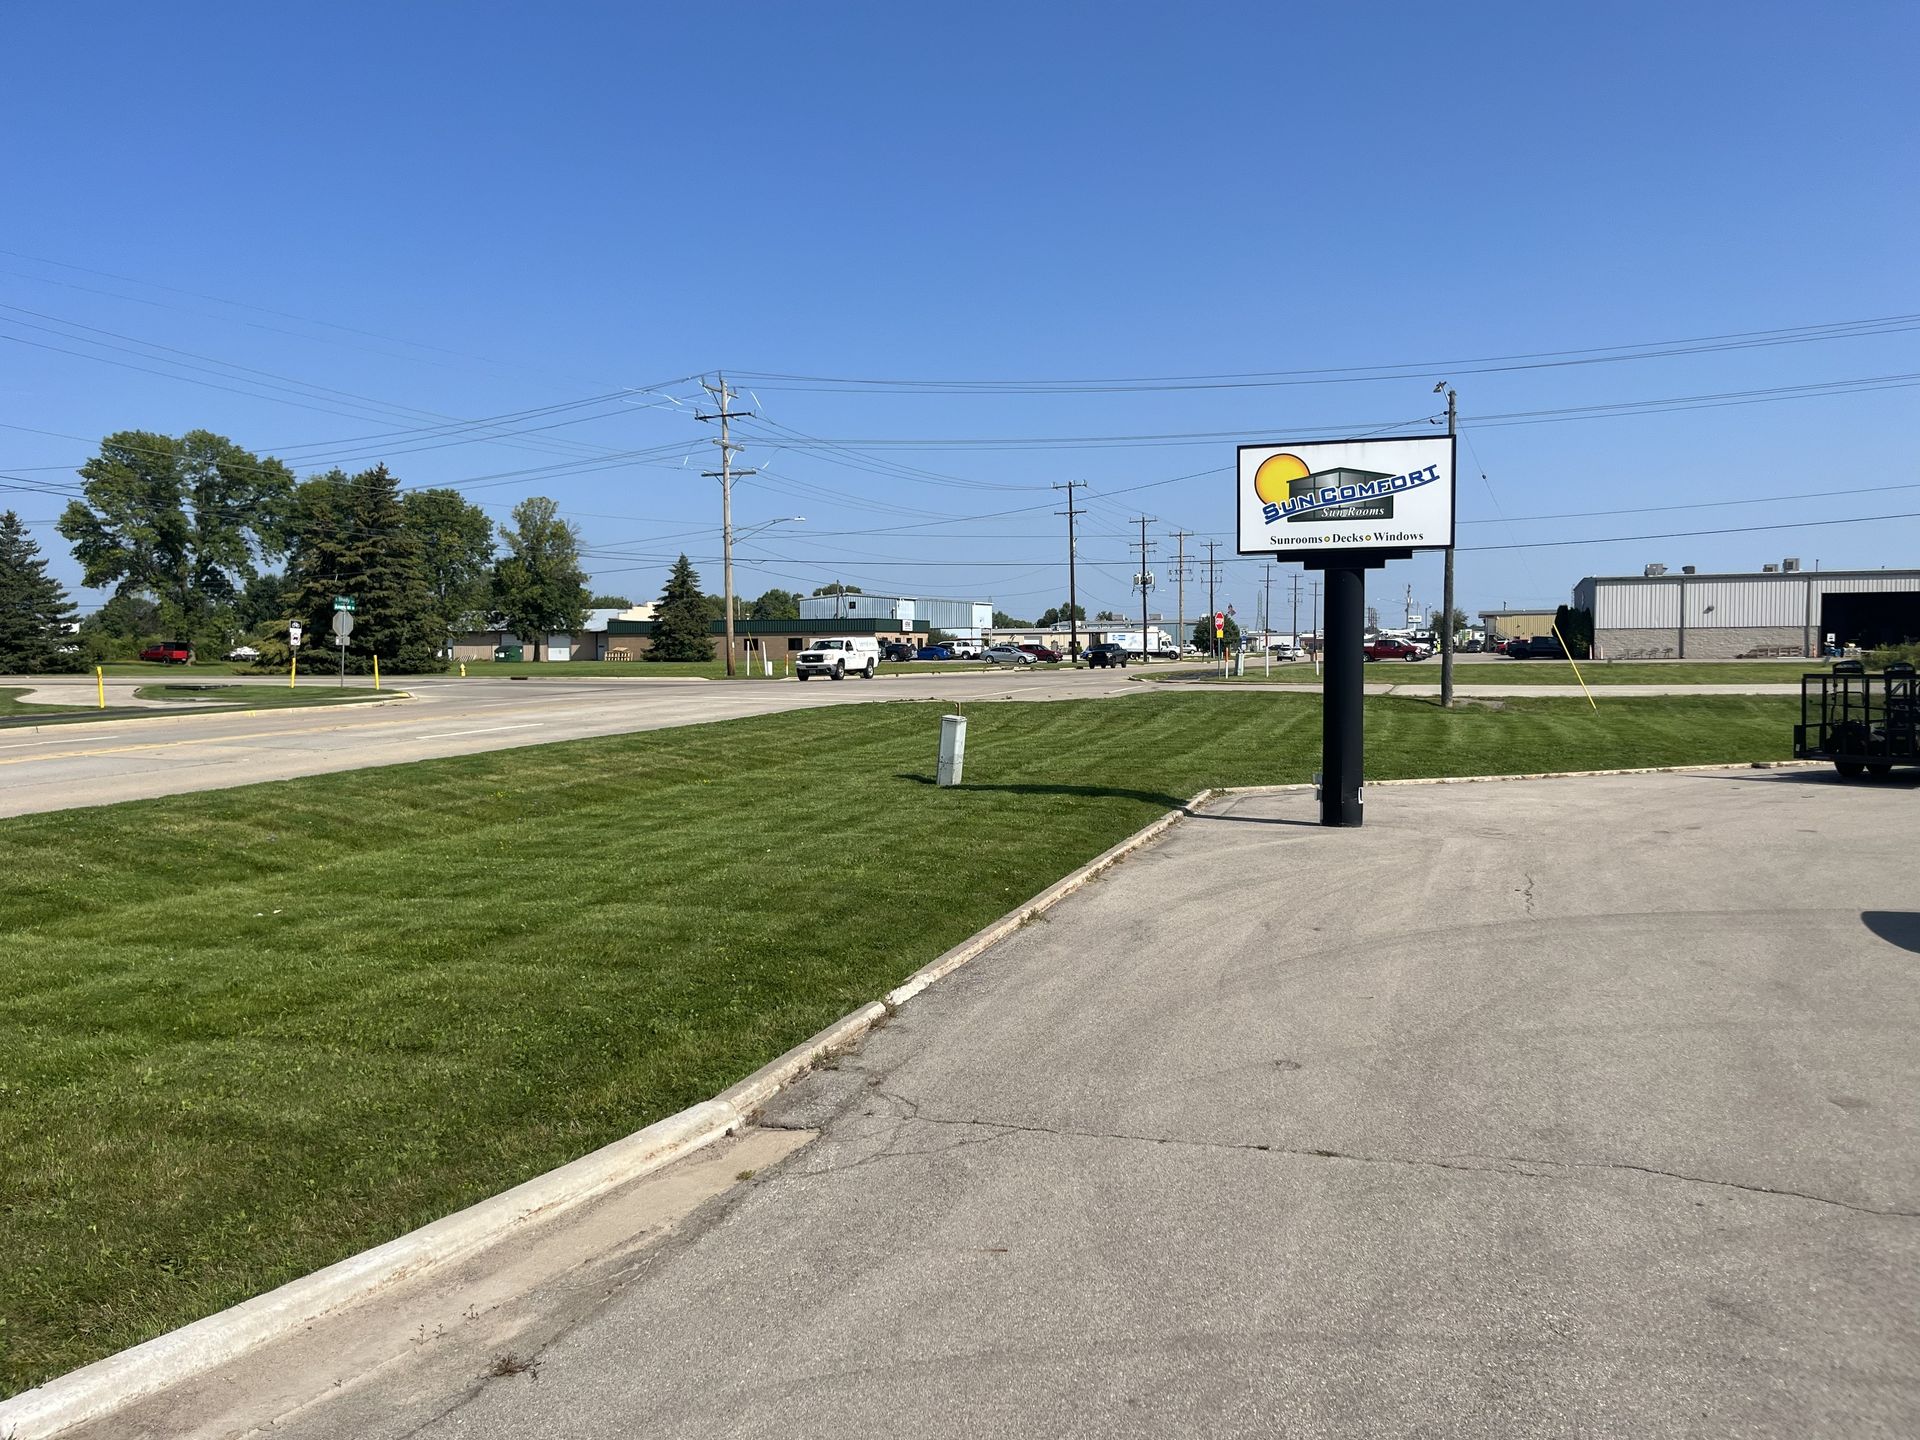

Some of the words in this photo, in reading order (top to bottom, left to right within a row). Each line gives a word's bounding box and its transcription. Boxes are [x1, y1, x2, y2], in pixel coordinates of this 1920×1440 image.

[1270, 535, 1323, 545] Sunrooms
[1332, 533, 1364, 543] Decks
[1373, 532, 1424, 541] Windows
